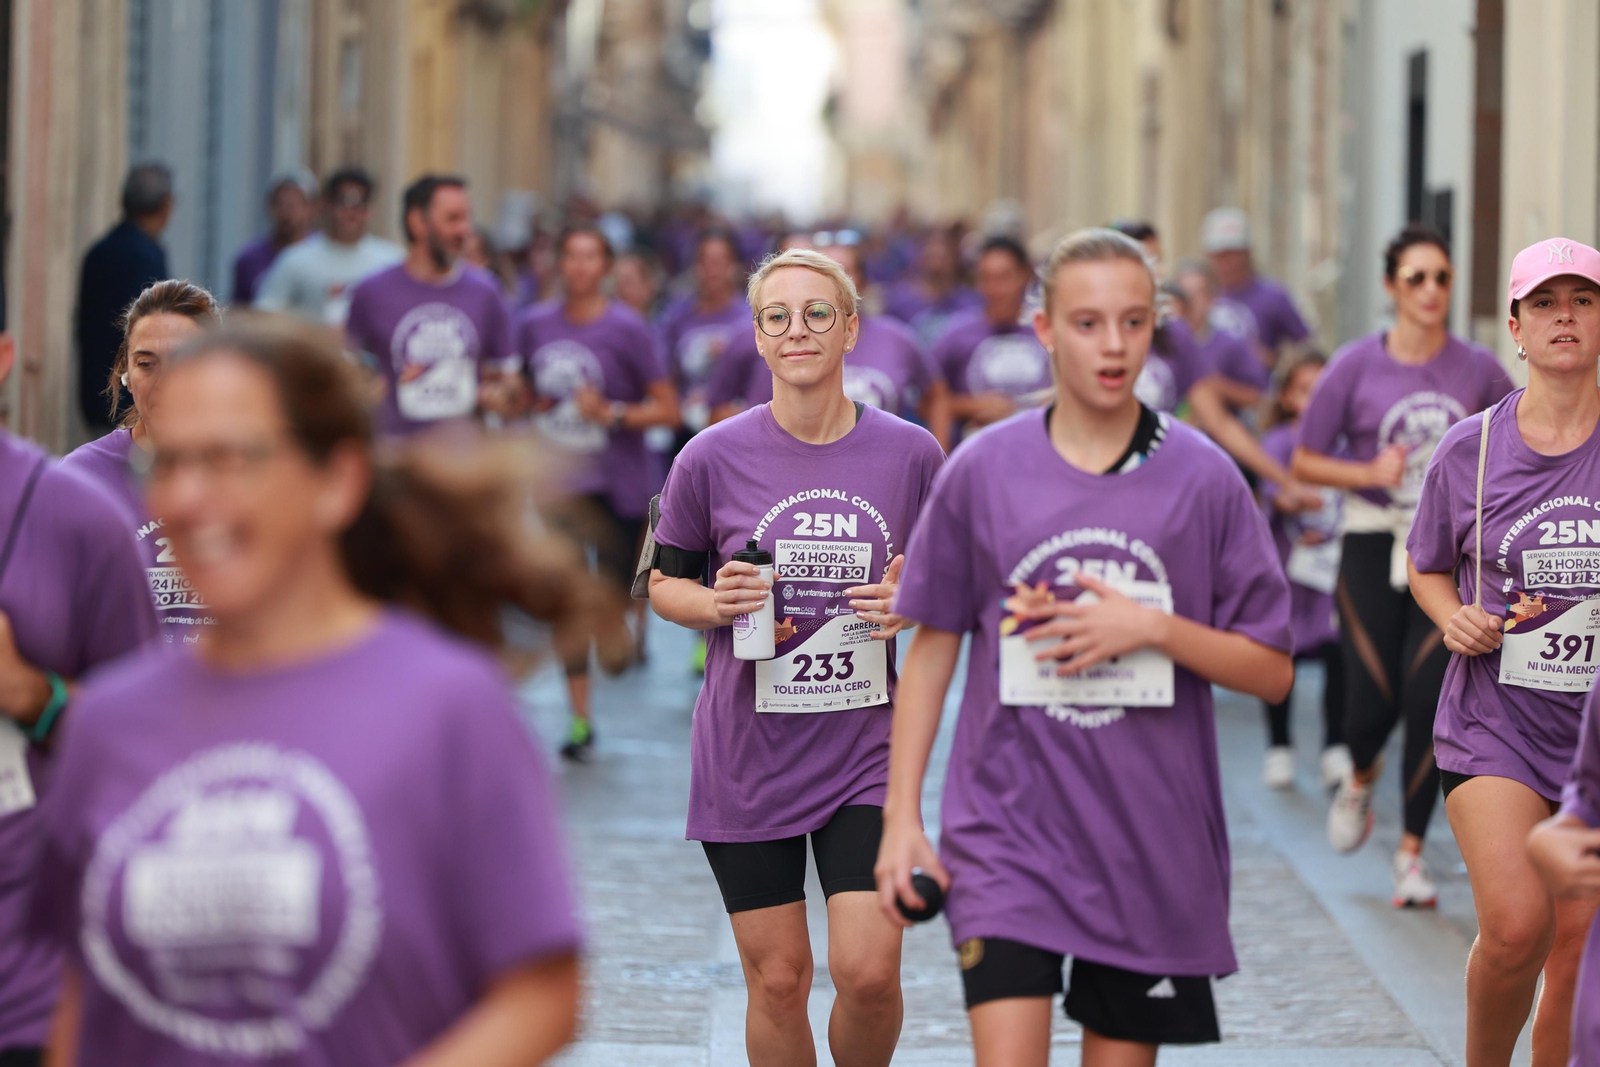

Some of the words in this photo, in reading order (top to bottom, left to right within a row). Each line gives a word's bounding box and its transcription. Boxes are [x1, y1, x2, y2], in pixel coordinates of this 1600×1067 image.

[752, 488, 849, 542] INTERNACIONAL
[851, 496, 891, 542] CONTRA
[885, 543, 894, 562] LA
[792, 512, 858, 538] 25N
[1498, 496, 1591, 556] INTERNACIONAL
[1537, 519, 1600, 545] 25N
[779, 542, 811, 550] SERVICIO
[822, 544, 869, 553] EMERGENCIAS
[790, 551, 806, 563] 24
[809, 552, 856, 564] HORAS
[1526, 551, 1556, 559] SERVICIO
[1537, 559, 1552, 570] 24
[1555, 558, 1600, 570] HORAS
[779, 565, 809, 577] 900
[812, 566, 825, 577] 21
[828, 566, 842, 578] 21
[845, 567, 863, 578] 30
[1529, 572, 1557, 585] 900
[1560, 572, 1572, 584] 21
[1575, 571, 1587, 583] 21
[152, 579, 168, 590] 24
[173, 592, 187, 604] 21
[796, 589, 834, 598] Ayuntamiento
[843, 621, 880, 632] CARRERA
[1539, 632, 1595, 662] 391
[791, 651, 854, 682] 233
[1527, 661, 1538, 670] NI
[1540, 663, 1563, 674] UNA
[773, 684, 842, 695] TOLERANCIA
[844, 680, 872, 692] CERO
